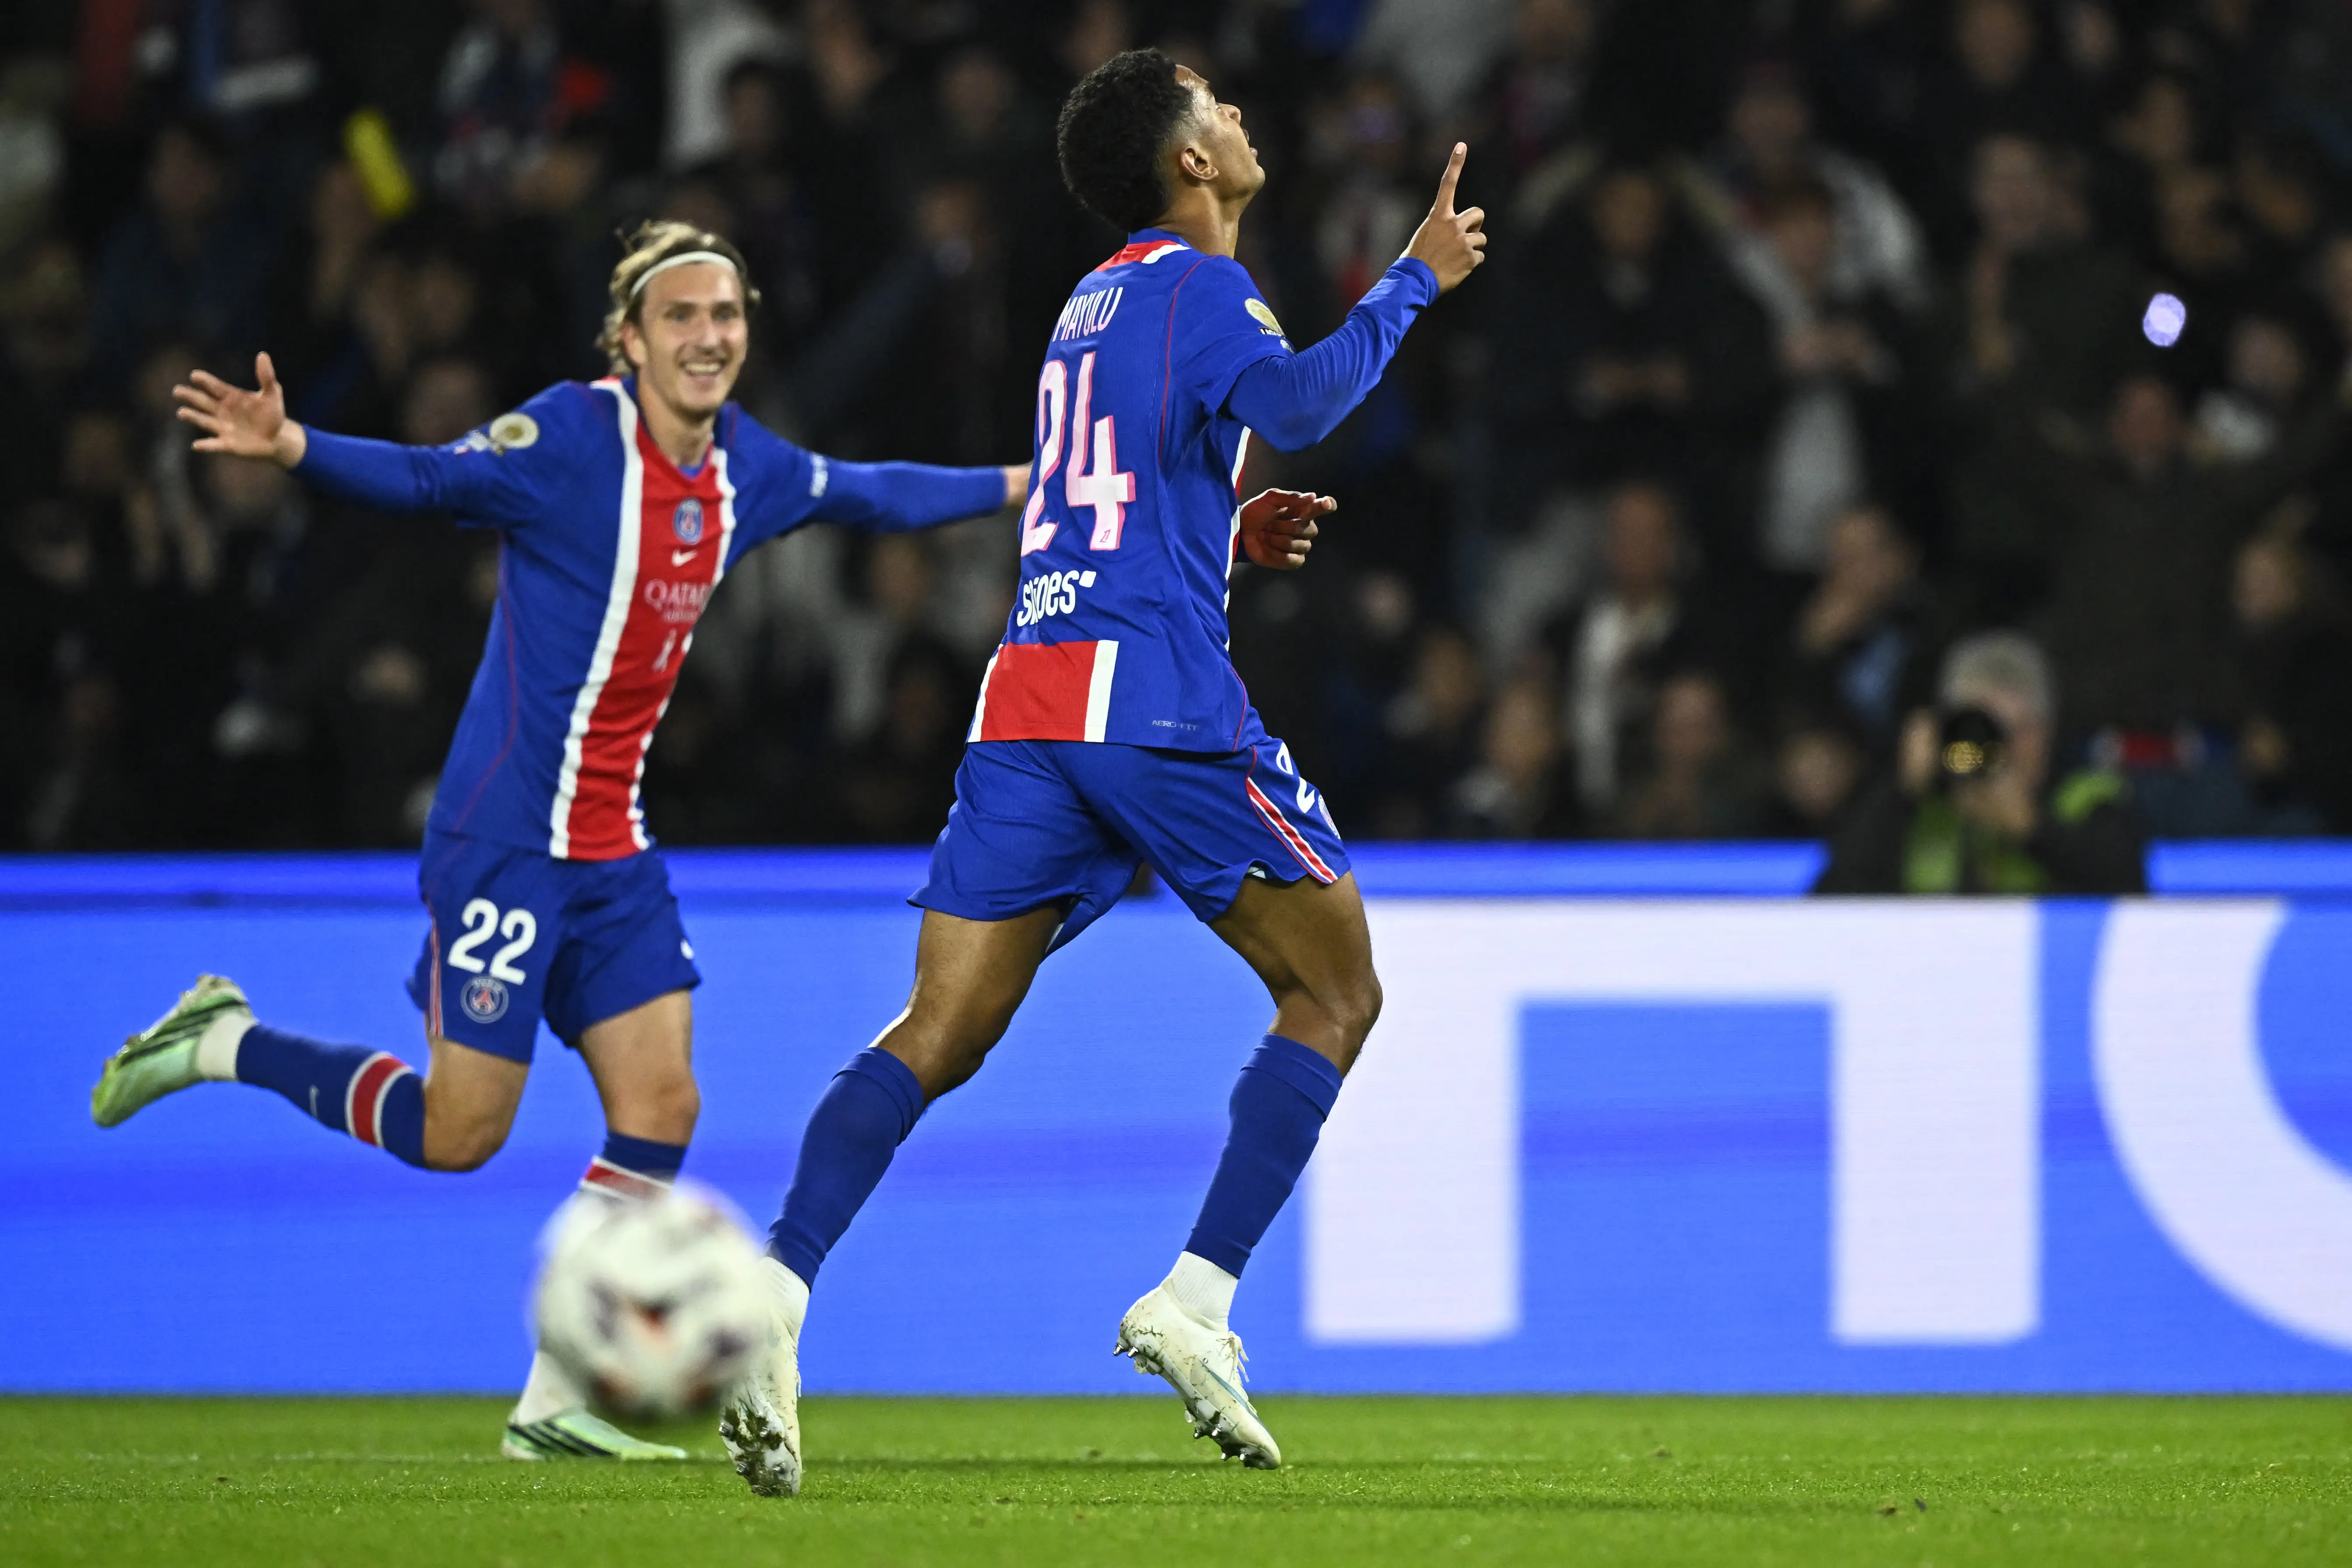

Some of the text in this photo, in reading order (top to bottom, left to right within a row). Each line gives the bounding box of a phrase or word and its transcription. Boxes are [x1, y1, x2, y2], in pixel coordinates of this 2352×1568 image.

[1052, 287, 1123, 342] MAYULU
[1021, 351, 1135, 557] 24
[448, 897, 537, 985] 22
